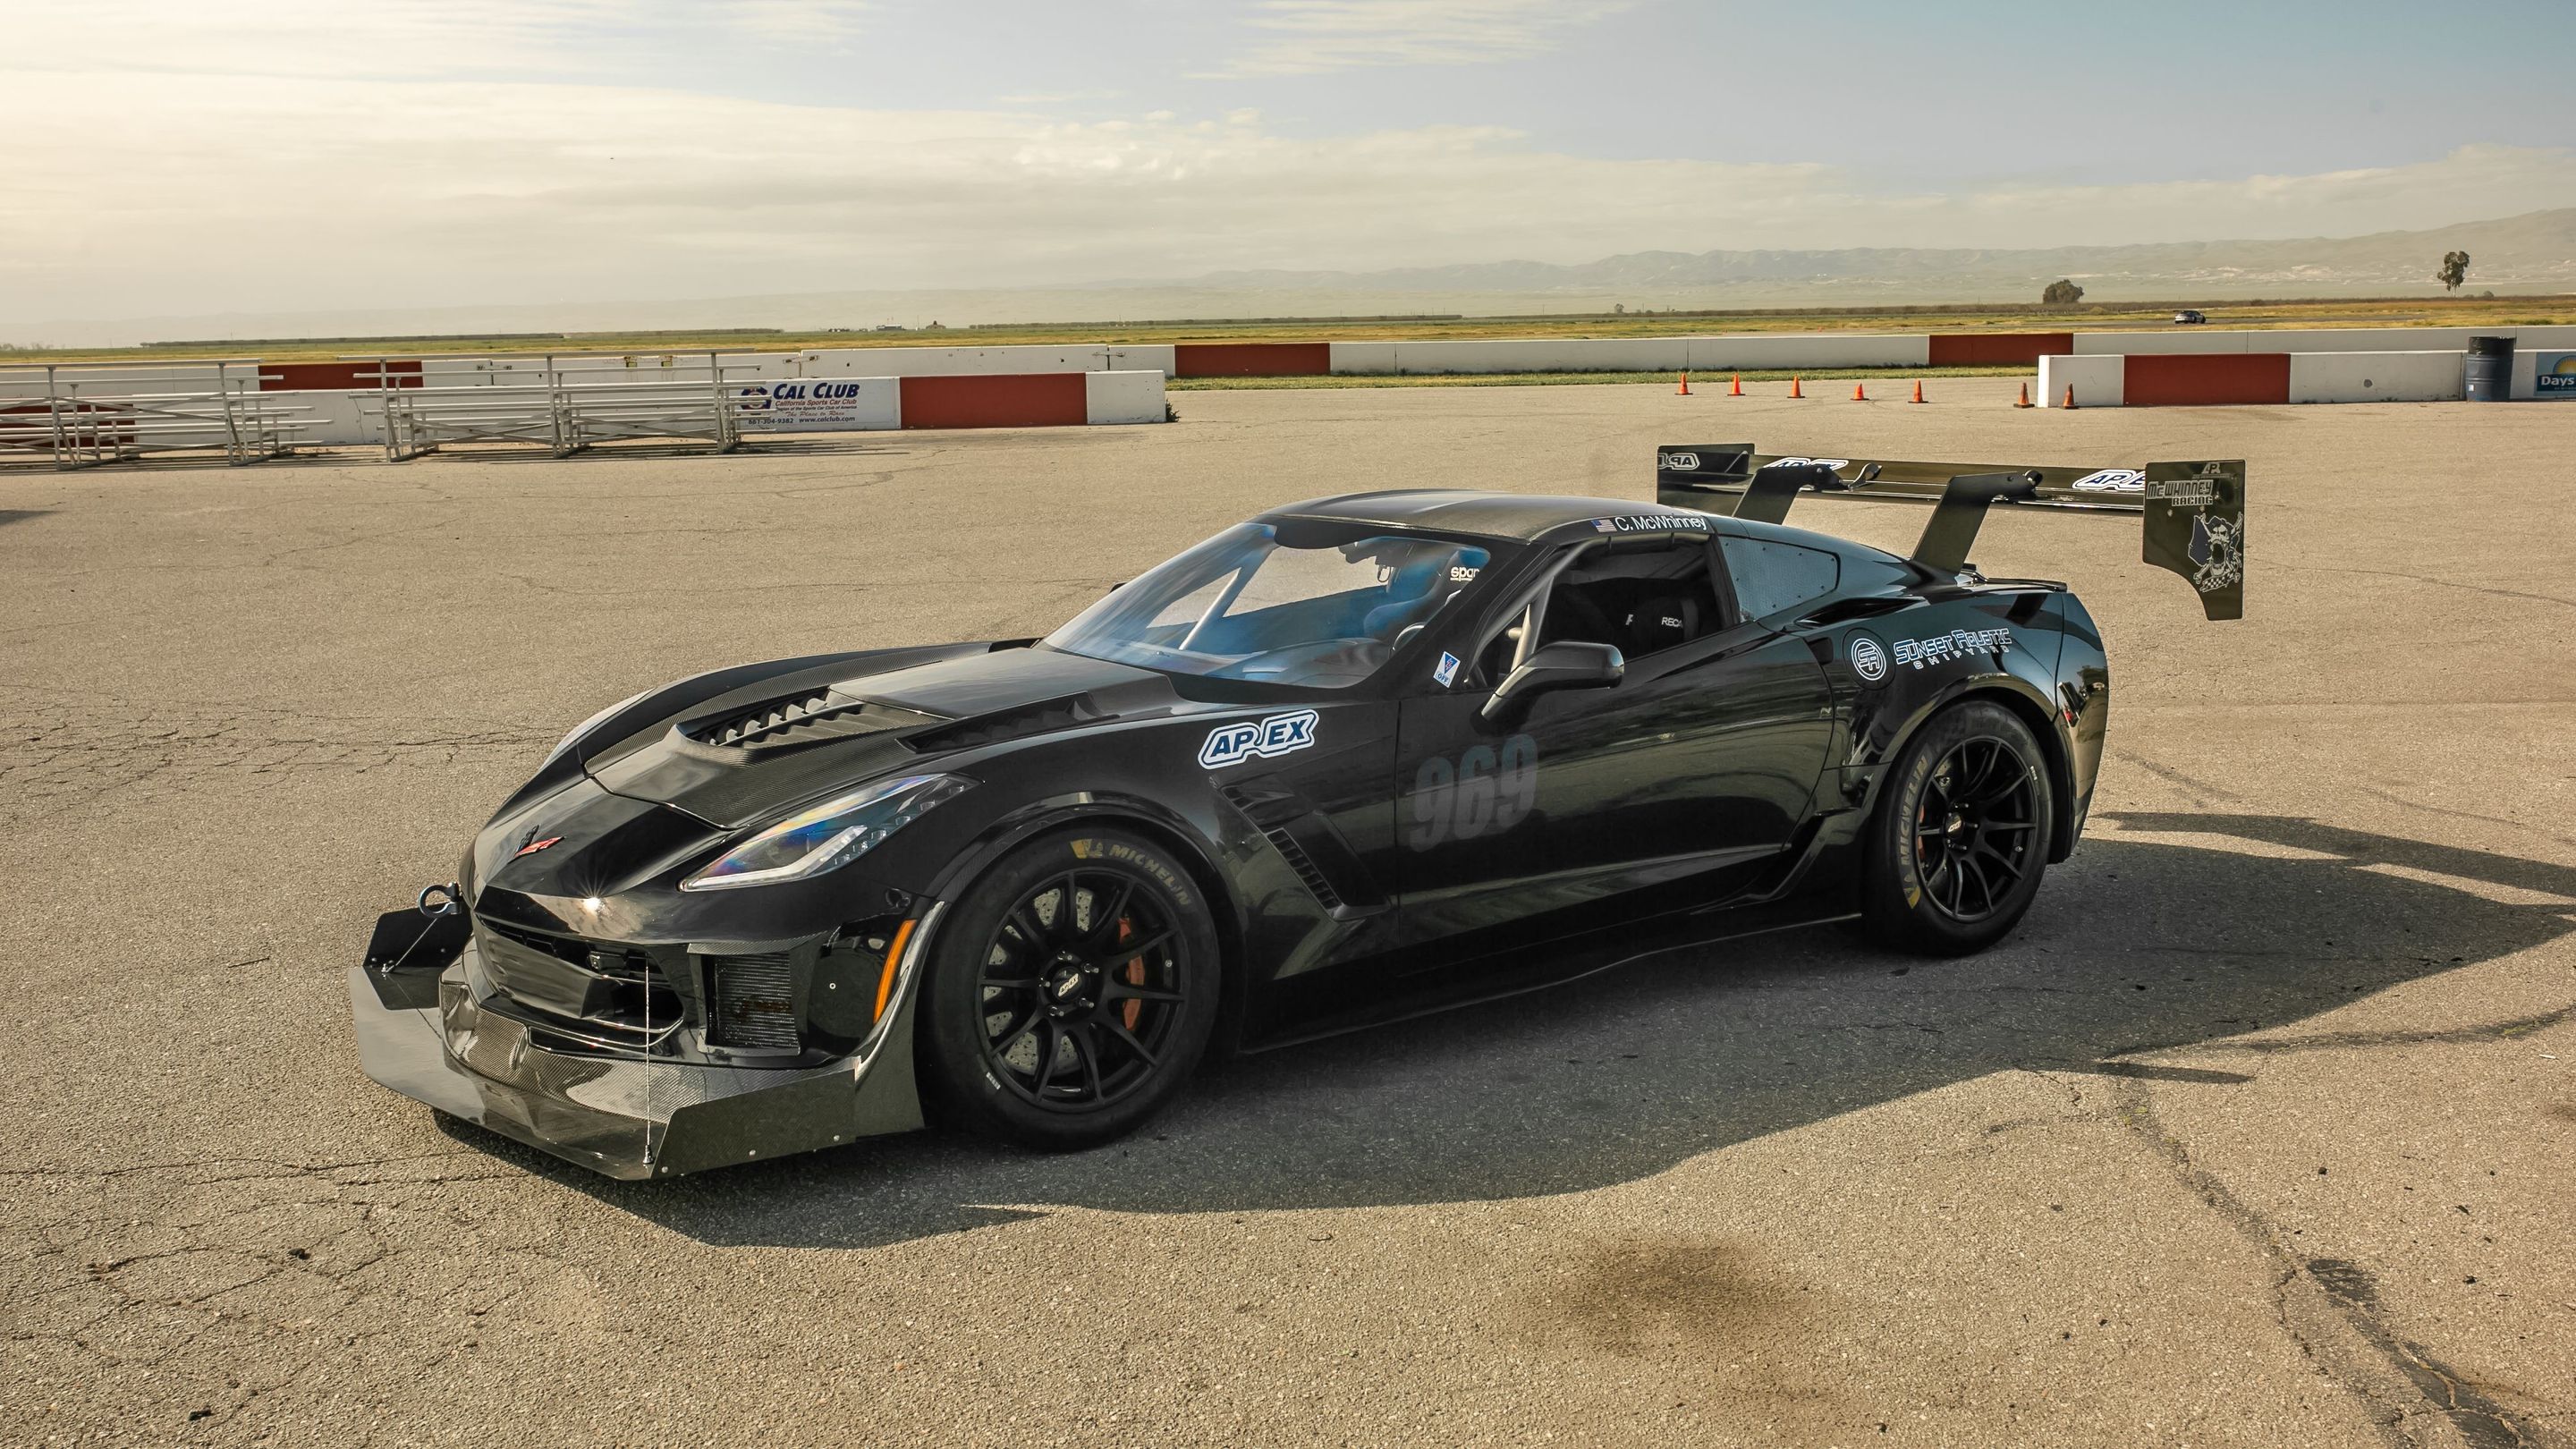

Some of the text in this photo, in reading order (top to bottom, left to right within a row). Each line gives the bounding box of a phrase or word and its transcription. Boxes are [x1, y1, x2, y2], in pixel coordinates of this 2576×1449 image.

[773, 382, 860, 399] CAL CLUB
[2541, 376, 2575, 386] Days
[806, 399, 827, 407] Sports
[2171, 496, 2214, 506] RACING
[1614, 514, 1707, 531] C. McWhinney
[1894, 628, 2012, 665] SUNSET AQUATIC
[1912, 645, 2010, 670] SHIPYARD
[1208, 716, 1310, 758] APEX
[1409, 734, 1538, 852] 969
[1109, 843, 1190, 905] MICHELIN
